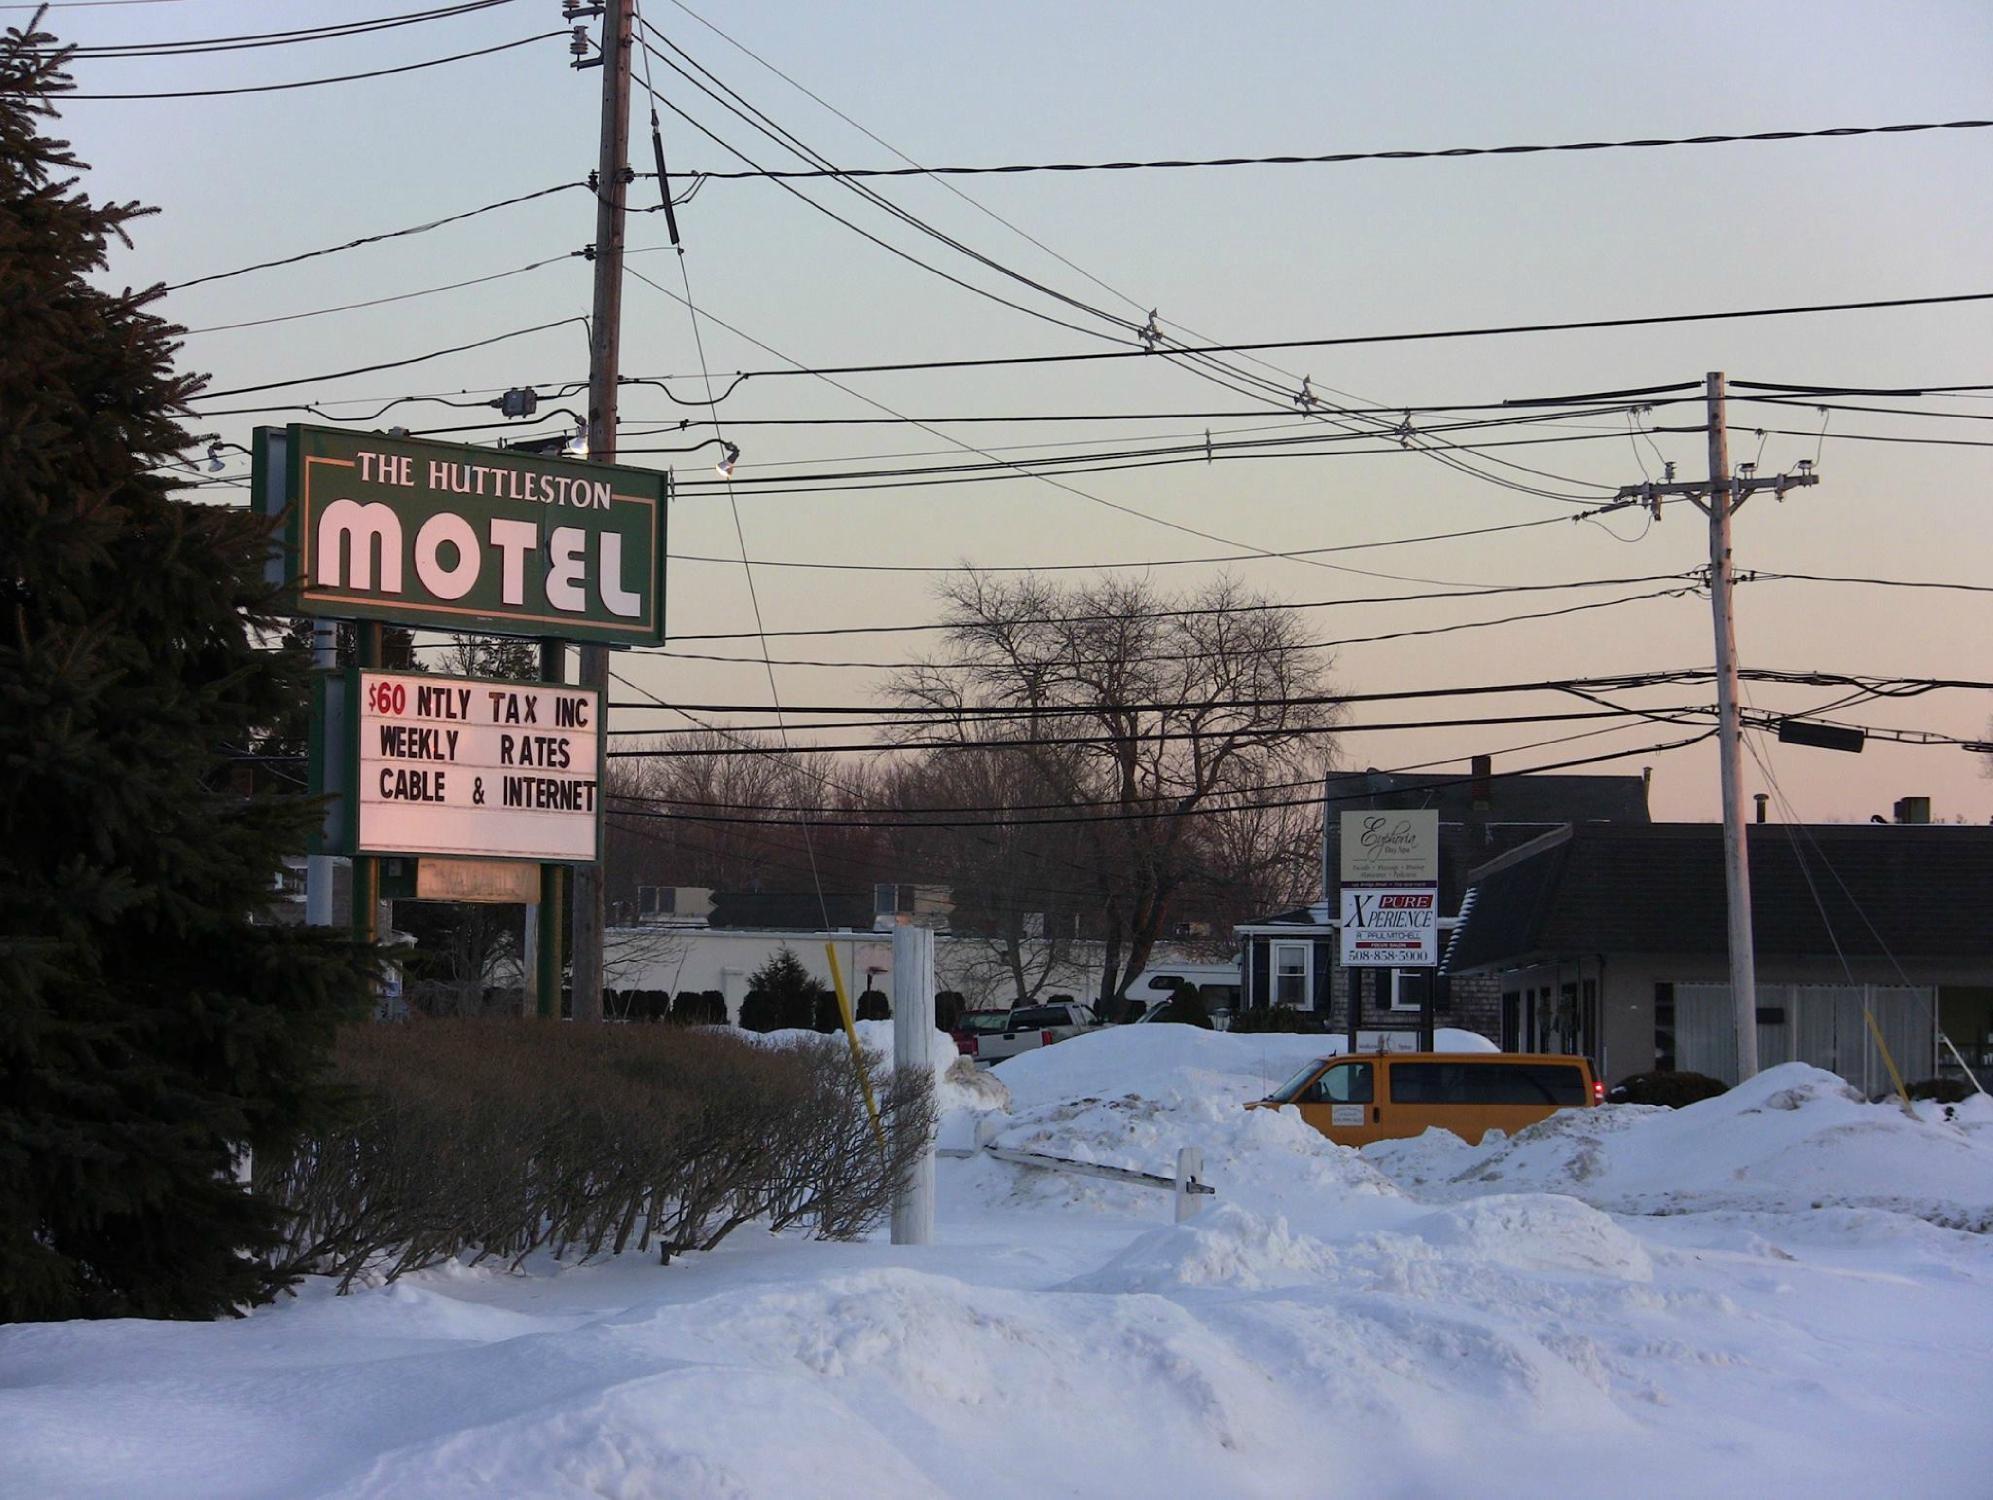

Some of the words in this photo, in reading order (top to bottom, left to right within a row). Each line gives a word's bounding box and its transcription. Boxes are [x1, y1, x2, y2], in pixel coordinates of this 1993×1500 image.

[357, 451, 415, 487] THE
[429, 460, 613, 511] HUTTLESTON
[318, 498, 641, 618] MOTEL
[368, 682, 406, 715] $60
[417, 686, 471, 720] NTLY
[488, 691, 538, 724] TAX
[555, 696, 589, 728] INC
[380, 725, 459, 761] WEEKLY
[501, 734, 571, 769] RATES
[379, 768, 446, 802] CABLE
[472, 776, 486, 805] &
[503, 775, 597, 812] INTERNET
[1380, 896, 1430, 908] PURE
